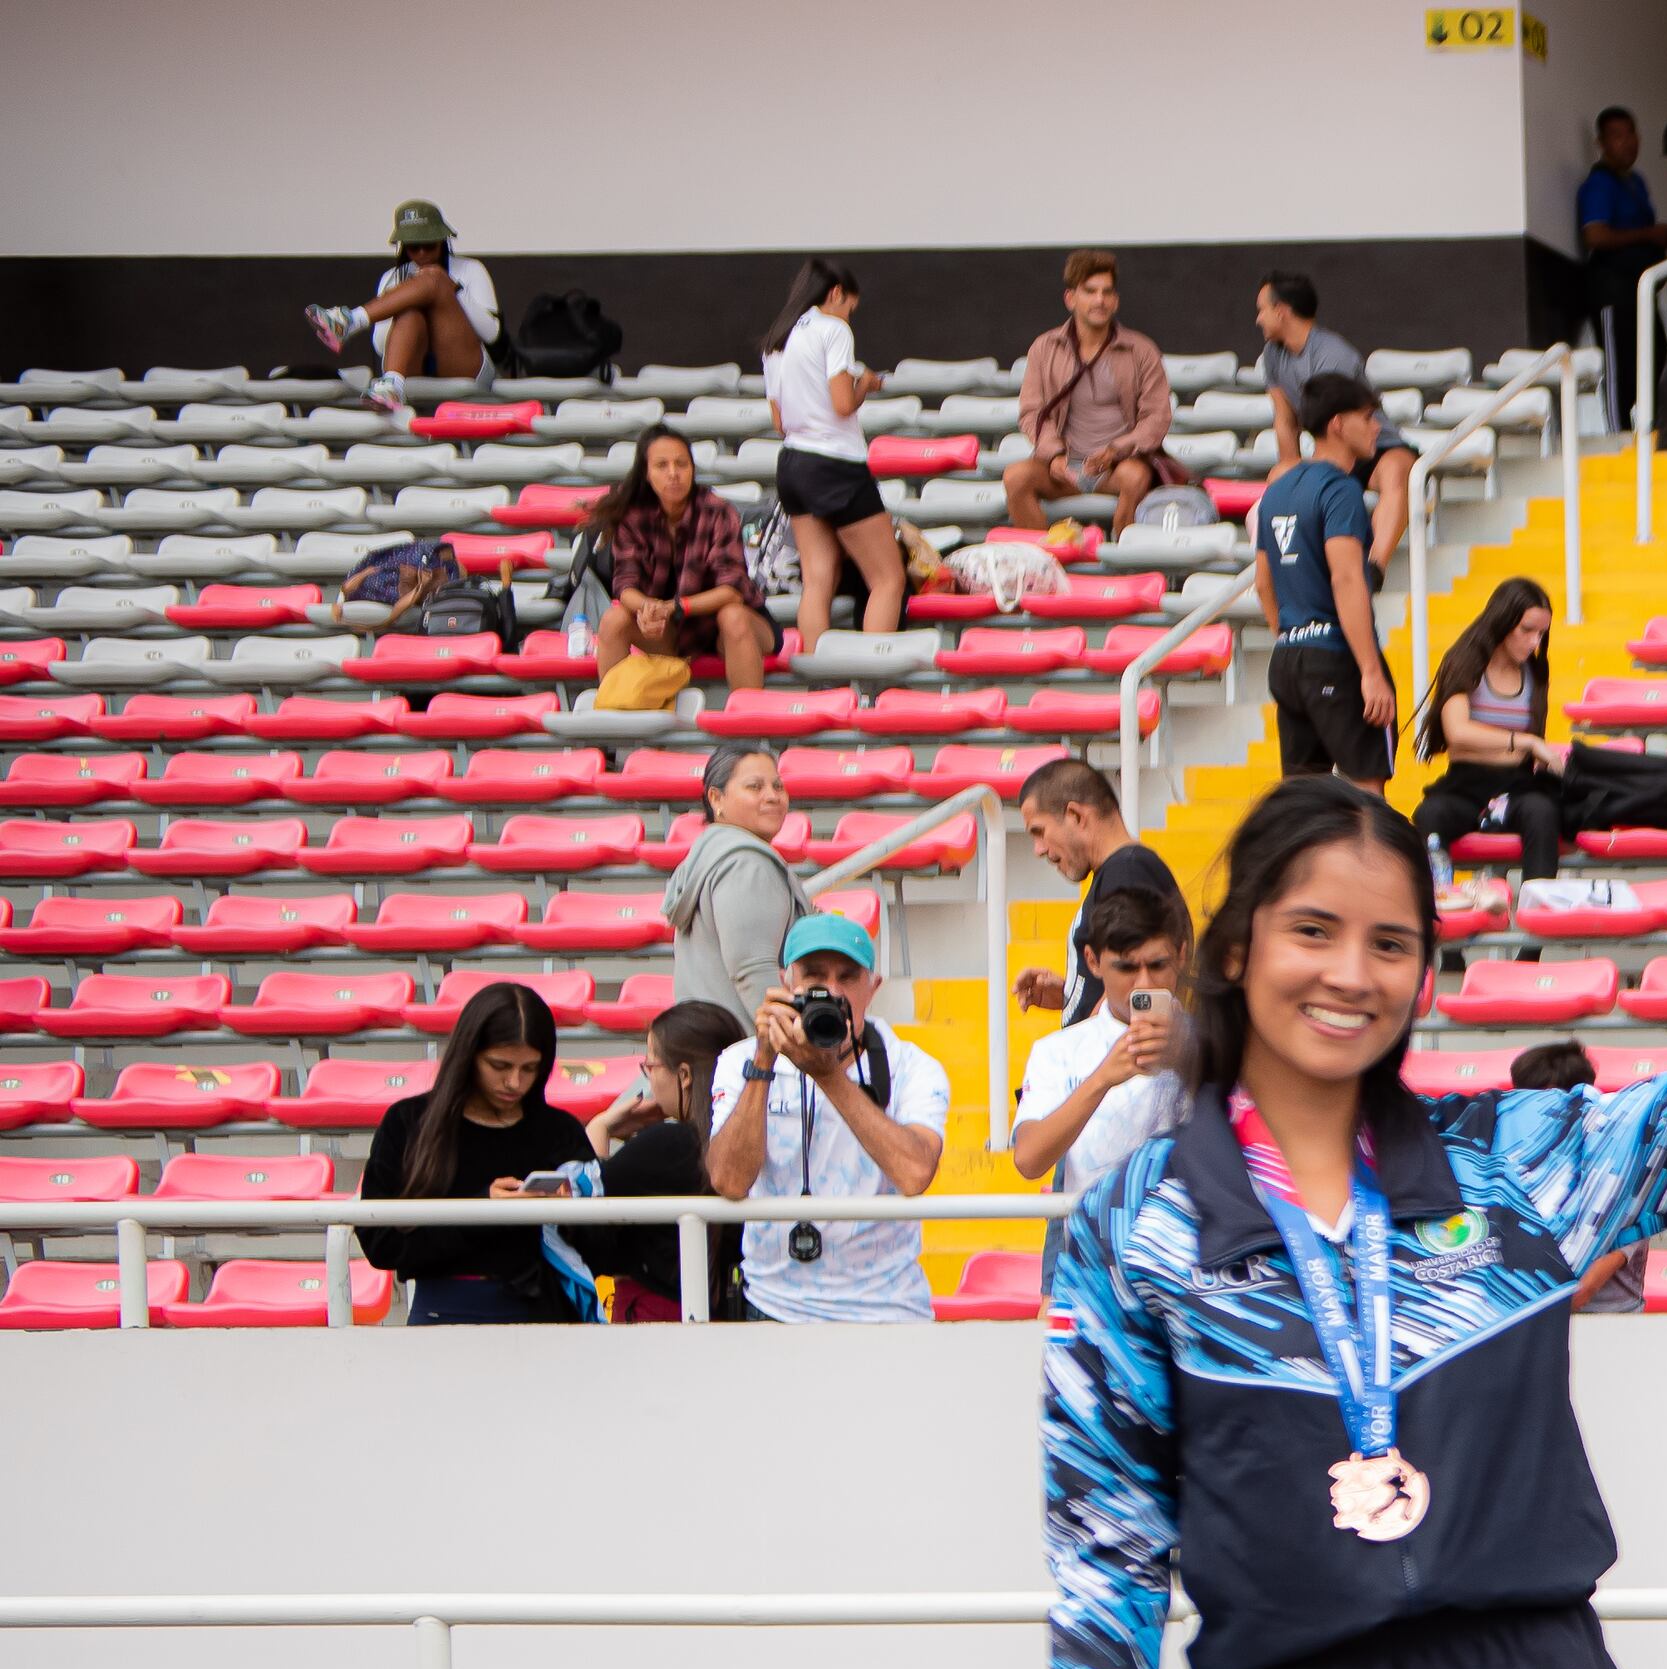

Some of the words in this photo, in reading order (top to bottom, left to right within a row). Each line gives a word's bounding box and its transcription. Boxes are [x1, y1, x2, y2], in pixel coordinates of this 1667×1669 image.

[1365, 1213, 1389, 1281] MAYOR
[1411, 1241, 1484, 1269] UNIVERSIDAD
[1190, 1254, 1271, 1290] UCR
[1306, 1257, 1347, 1327] MAYOR
[1415, 1260, 1466, 1281] COSTA
[1370, 1403, 1393, 1455] YOR
